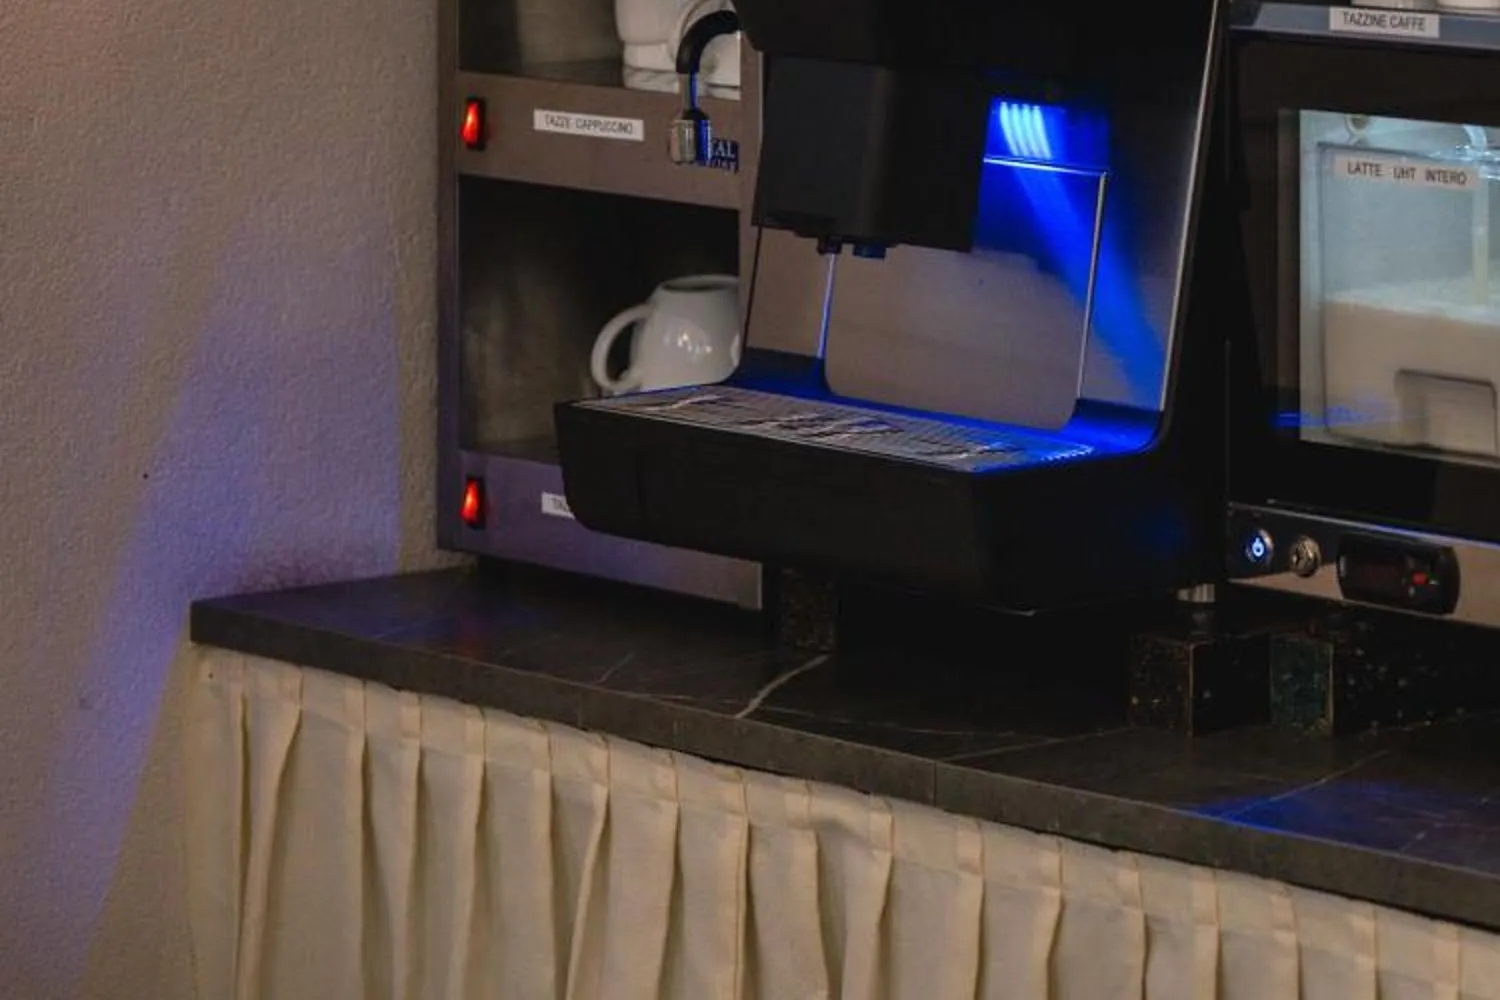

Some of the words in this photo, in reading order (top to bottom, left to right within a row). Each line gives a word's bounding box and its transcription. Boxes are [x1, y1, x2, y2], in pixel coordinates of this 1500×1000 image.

[1342, 12, 1388, 27] TAZZINE
[1347, 161, 1383, 177] LATTE
[1425, 168, 1468, 186] INTERO
